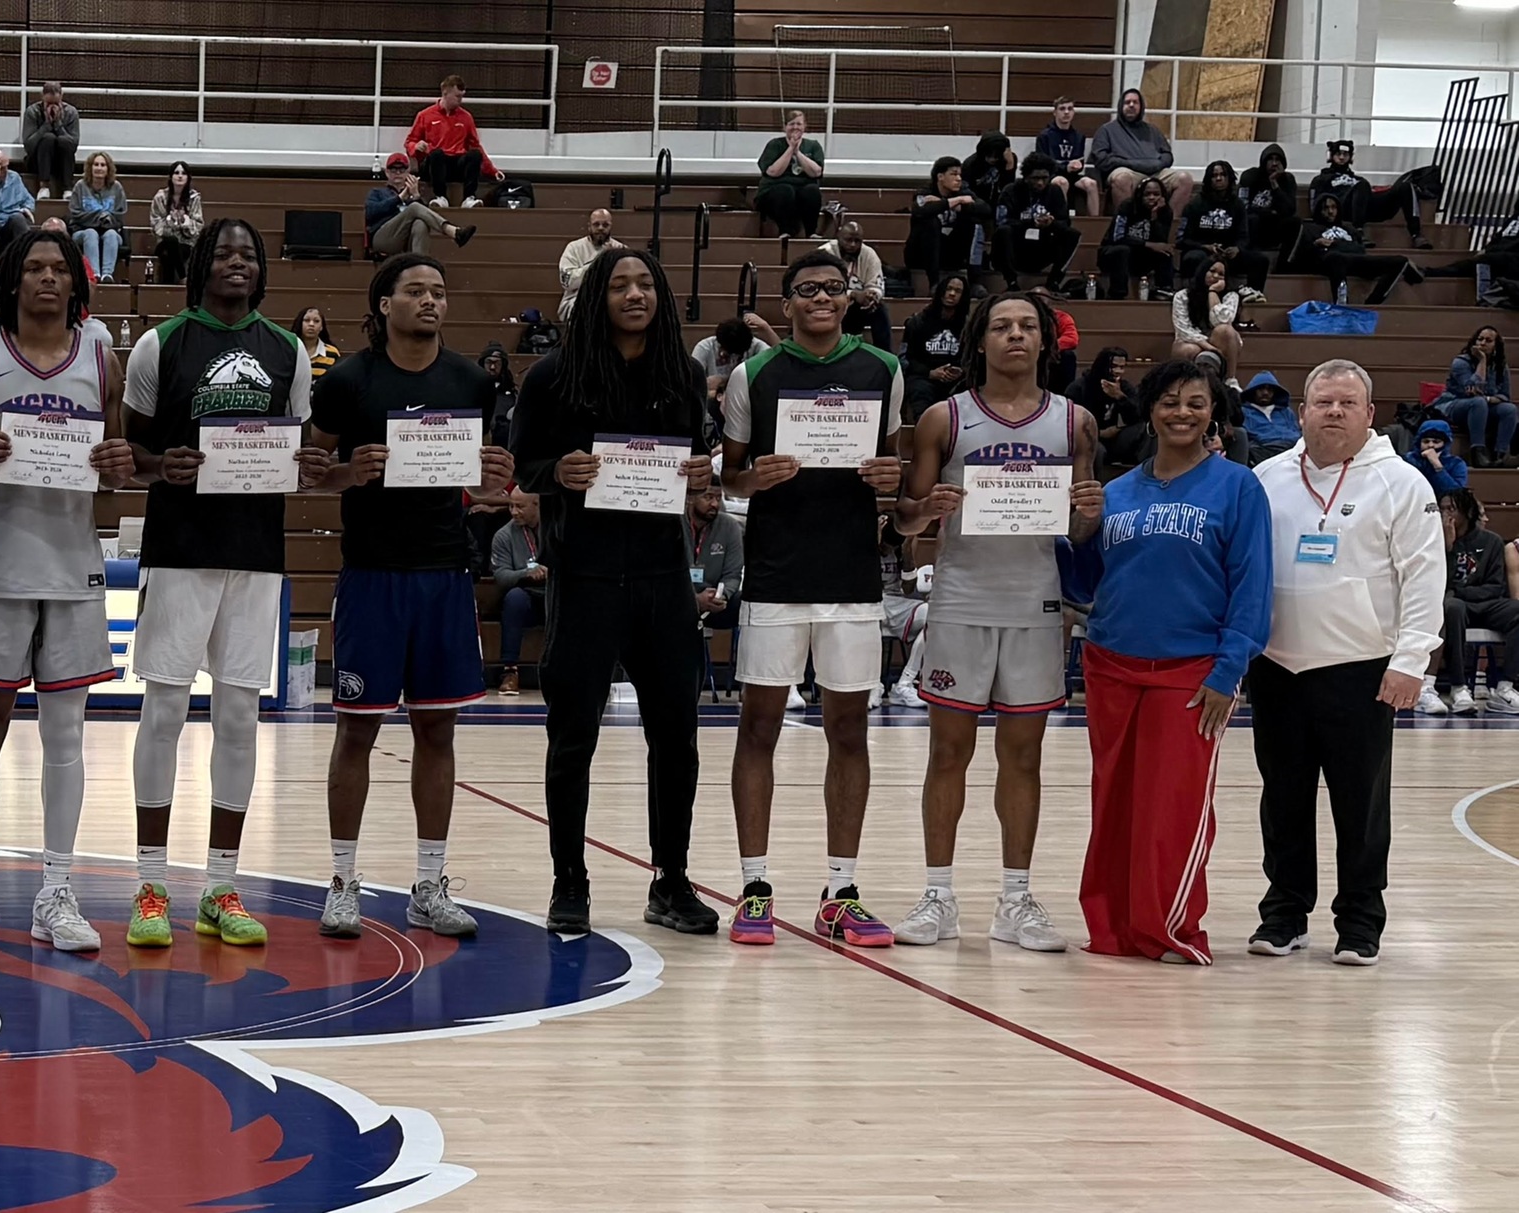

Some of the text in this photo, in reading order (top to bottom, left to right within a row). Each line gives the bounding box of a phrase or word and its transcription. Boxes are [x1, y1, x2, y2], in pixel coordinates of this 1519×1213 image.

[197, 384, 230, 393] COLUMBIA
[191, 390, 271, 419] CHARGERS
[790, 414, 869, 423] MEN'S BASKETBALL
[13, 429, 92, 444] MEN'S BASKETBALL
[398, 433, 473, 442] MEN'S BASKETBALL
[238, 441, 290, 449] BASKETBALL
[603, 456, 678, 468] MEN'S BASKETBALL
[976, 480, 1060, 489] MEN'S BASKETBALL
[1103, 503, 1208, 551] VOL STATE
